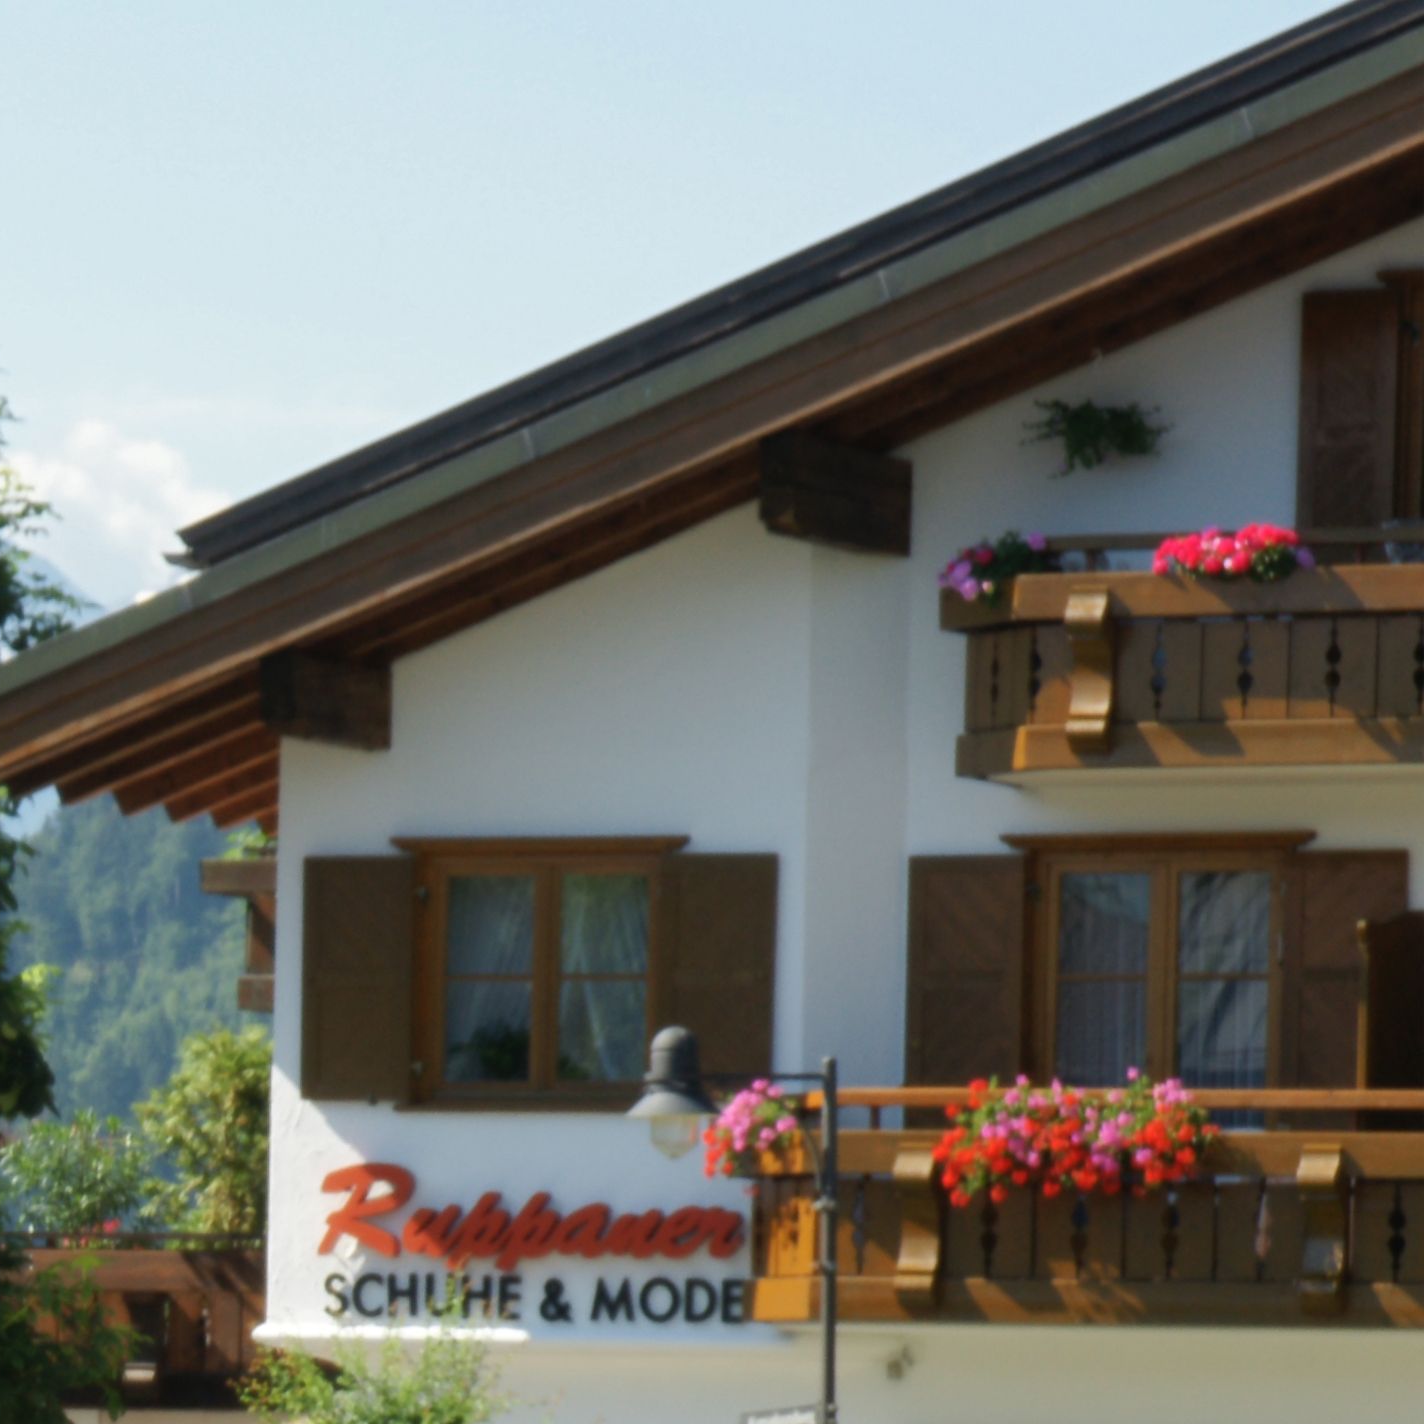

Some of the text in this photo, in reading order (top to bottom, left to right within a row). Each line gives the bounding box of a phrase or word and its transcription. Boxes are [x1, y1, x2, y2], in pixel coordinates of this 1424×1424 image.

[318, 1162, 744, 1270] Ruppaner
[324, 1272, 745, 1323] SCHUHE & MODE
